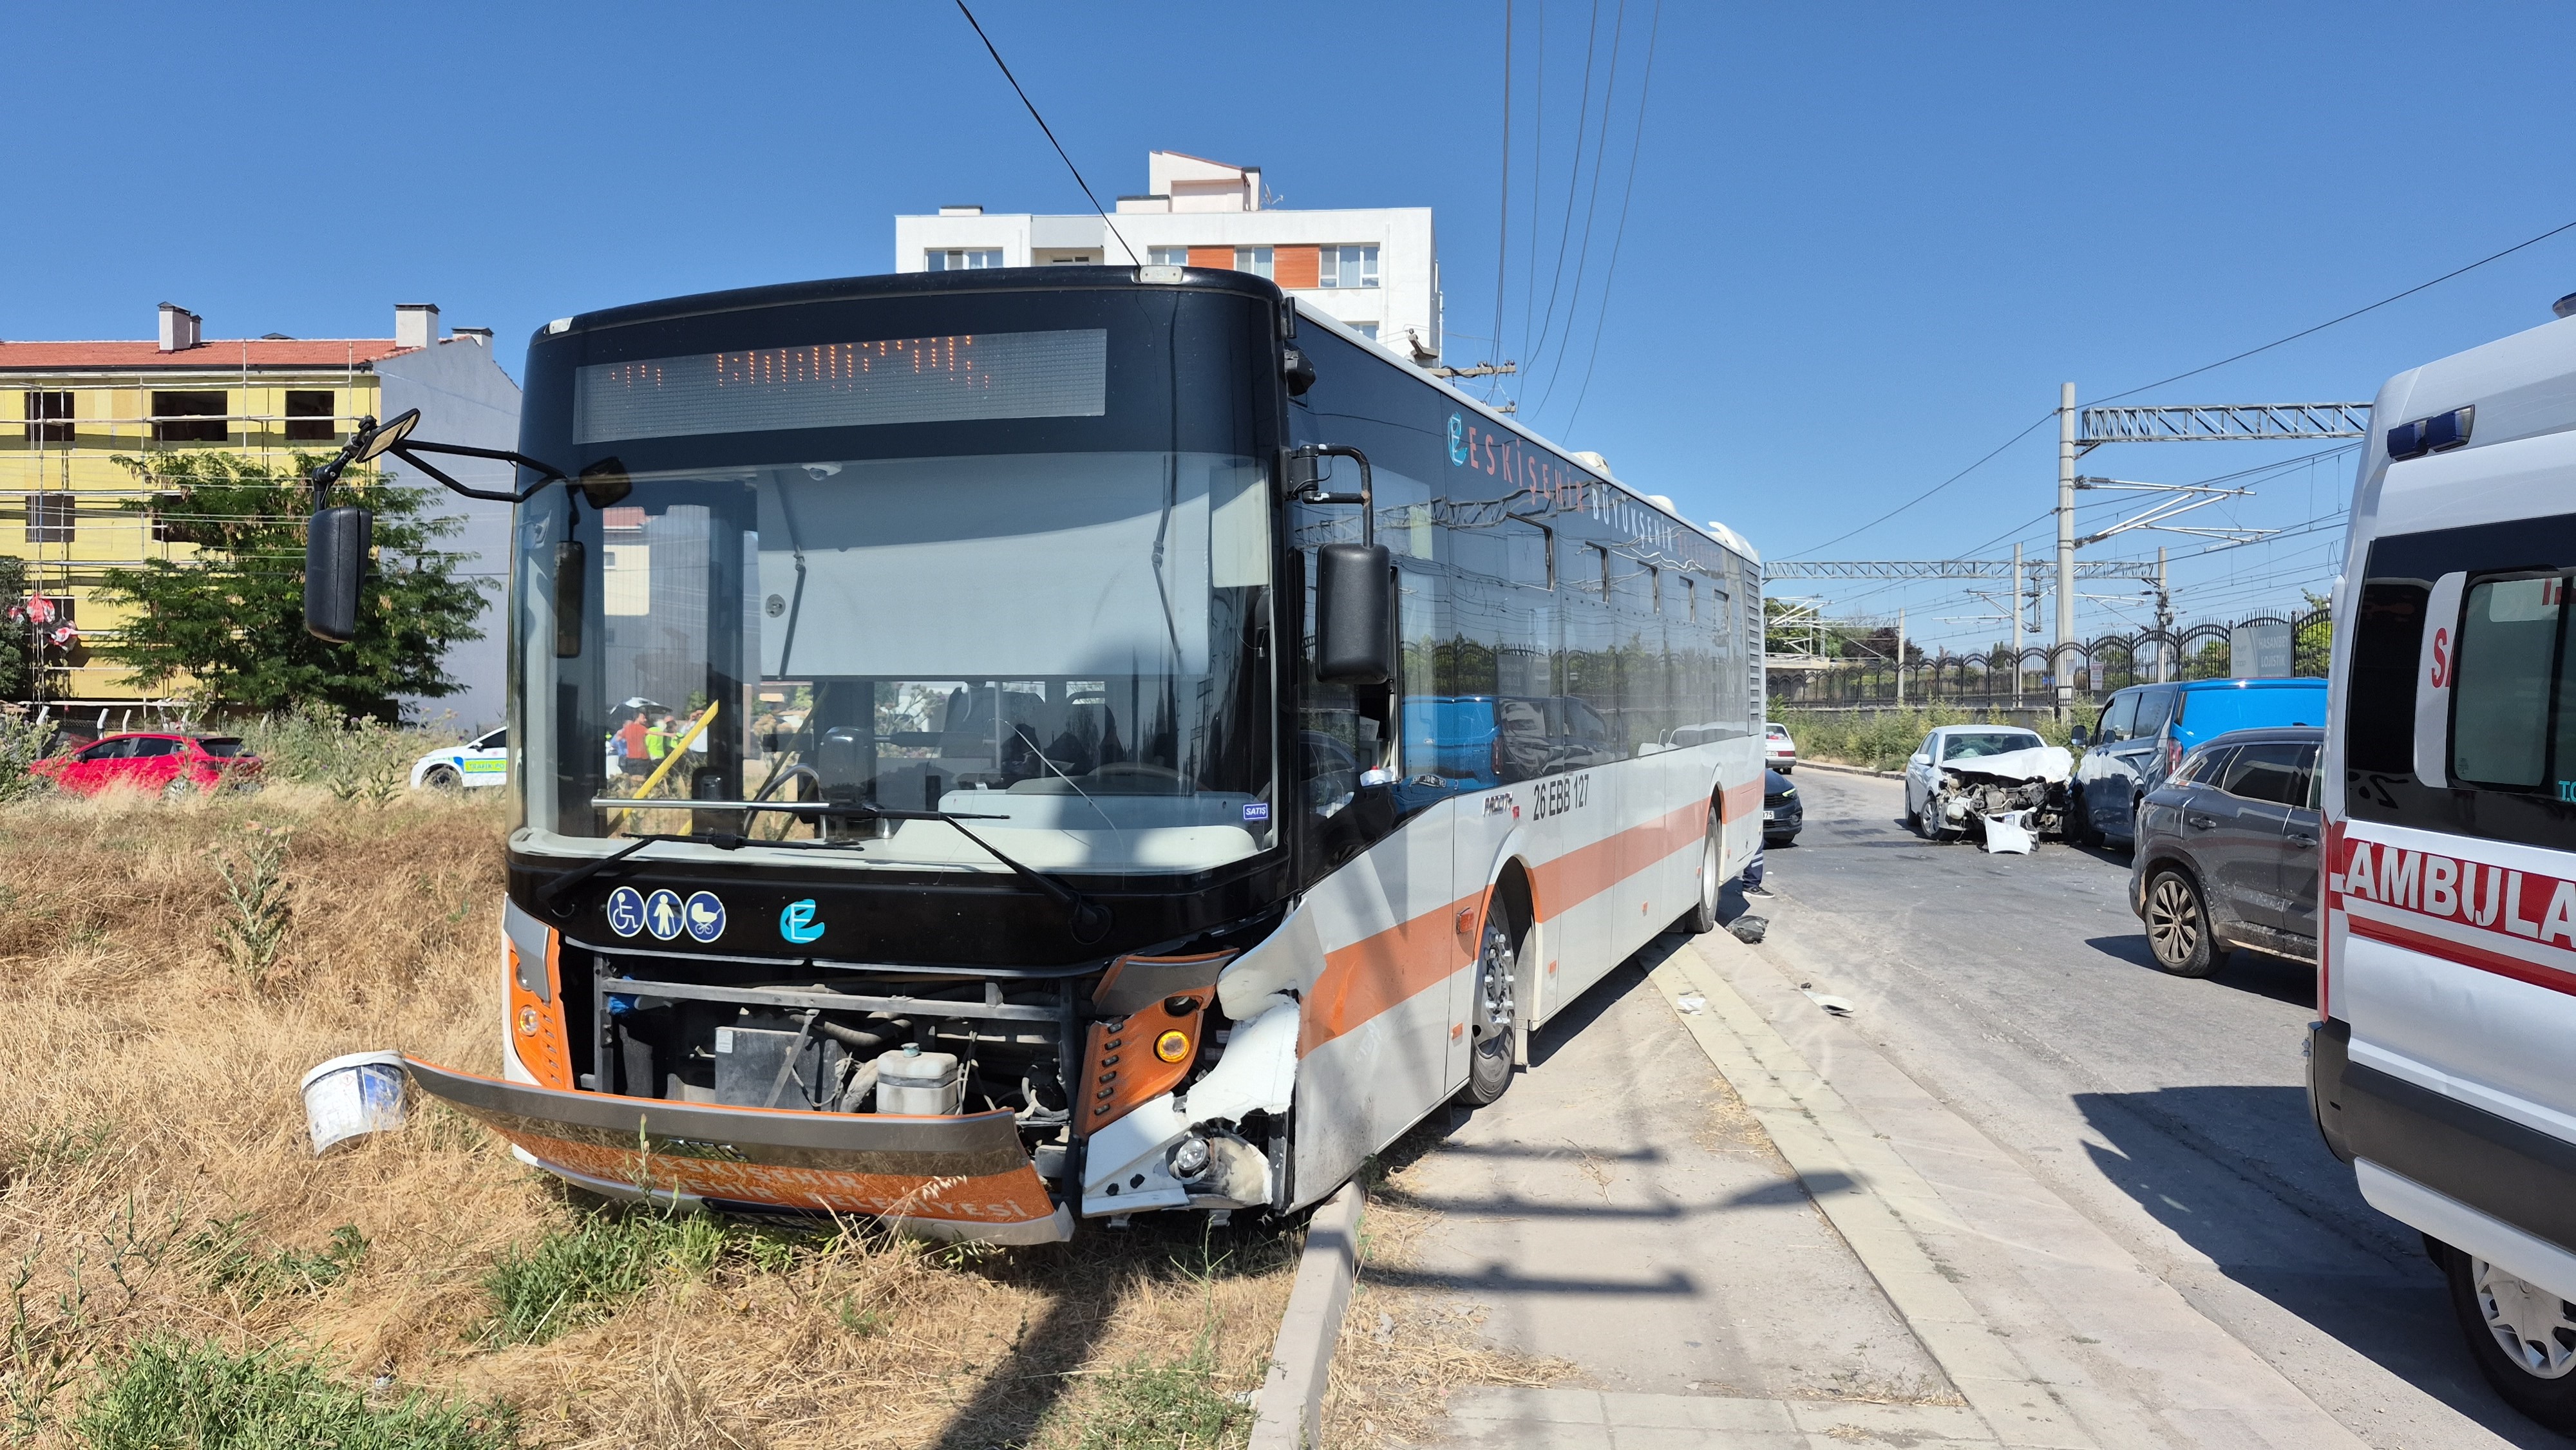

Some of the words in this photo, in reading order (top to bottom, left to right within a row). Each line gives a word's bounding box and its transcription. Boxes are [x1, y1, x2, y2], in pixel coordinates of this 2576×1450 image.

[1469, 426, 1584, 514] ESKİŞEHİR
[1592, 482, 1672, 552] BÜYÜKŞEHİR
[2259, 636, 2289, 649] HASANBEY
[1246, 807, 1266, 815] SATIŞ
[1533, 783, 1546, 821] 26
[1549, 778, 1570, 816] EBB
[1573, 773, 1589, 809] 127
[2345, 841, 2576, 948] AMBULA
[654, 1156, 864, 1189] ESKİŞEHİR
